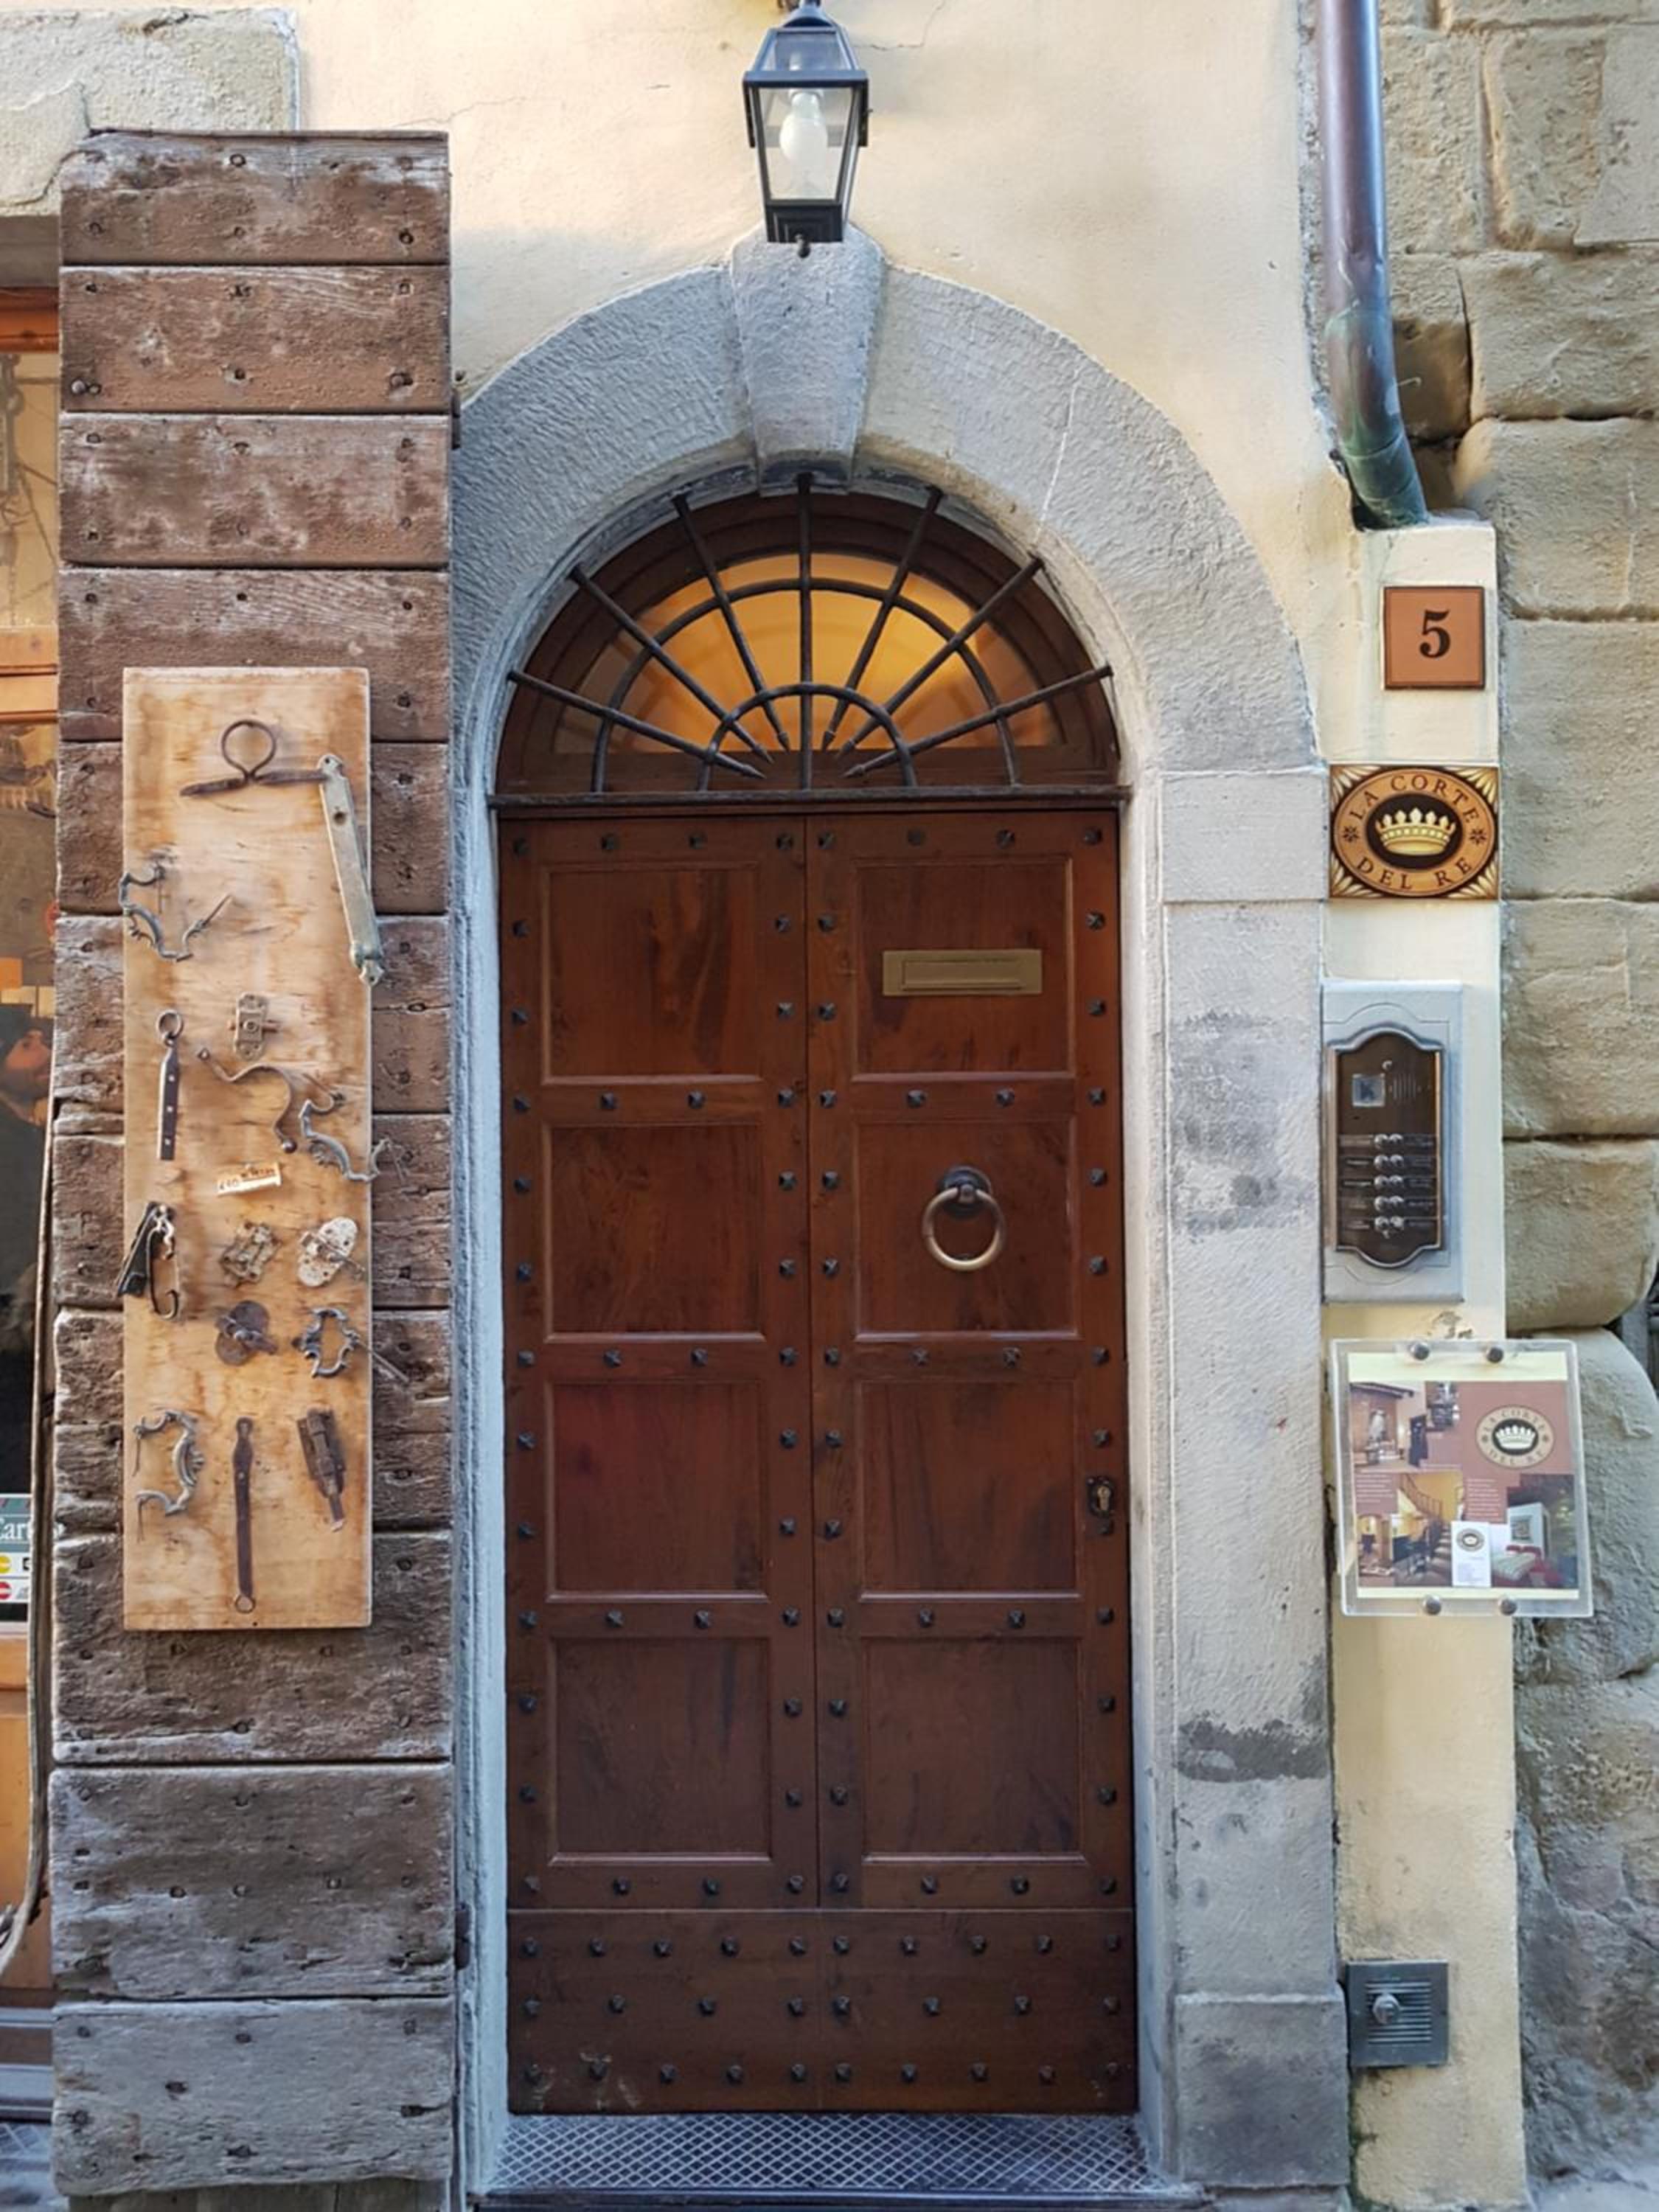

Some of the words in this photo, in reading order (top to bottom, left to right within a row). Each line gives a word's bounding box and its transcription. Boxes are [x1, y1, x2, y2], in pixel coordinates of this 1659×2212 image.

[1419, 609, 1451, 658] 5
[1349, 789, 1380, 821] LA
[1390, 774, 1480, 824] CORTE
[1356, 856, 1413, 891] DEL
[1433, 856, 1472, 887] RE
